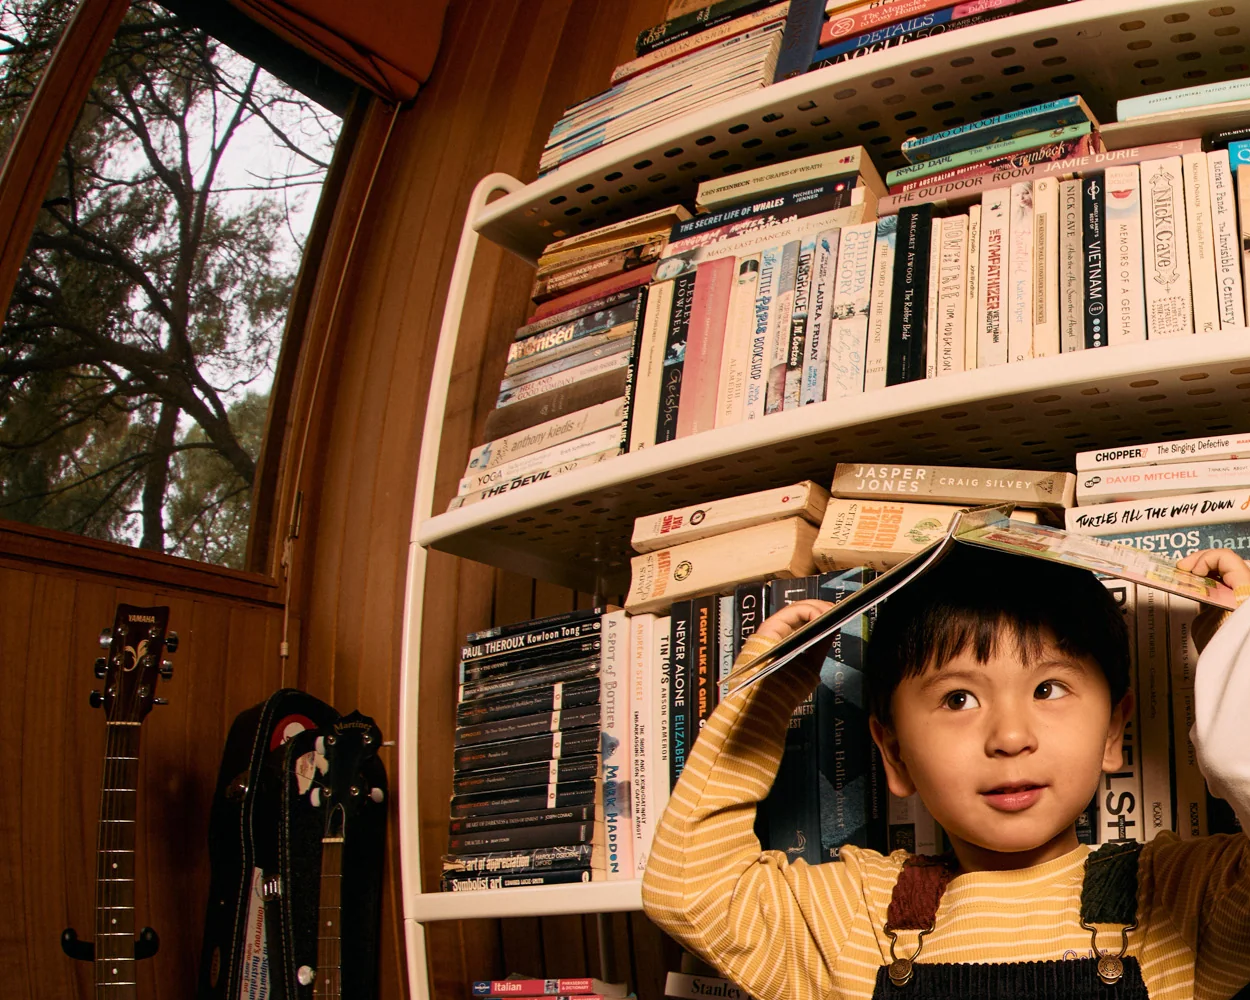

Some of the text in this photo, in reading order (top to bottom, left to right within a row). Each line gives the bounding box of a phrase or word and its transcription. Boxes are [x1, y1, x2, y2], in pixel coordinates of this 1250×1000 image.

[857, 14, 935, 47] DETAILS
[716, 180, 750, 195] STEINBECK
[892, 148, 1139, 204] THE OUTDOOR ROOM JAMIE DURIE
[680, 197, 784, 233] THE SECRET LIFE WHALES
[1066, 185, 1075, 238] NICK CAVE
[755, 230, 791, 245] DANCER
[840, 231, 858, 296] GREGORY
[857, 230, 872, 293] PHILIPPA
[987, 236, 1001, 310] SYMPATHIZER
[1088, 240, 1103, 300] VIETNAM
[1219, 233, 1236, 325] Invisible Century
[672, 279, 688, 335] DOWNER
[810, 283, 826, 361] LAURA FRIDAY
[750, 337, 765, 380] BOOKSHOP
[665, 369, 682, 426] Geisha
[1095, 438, 1230, 462] CHOPPER Singing Defective
[855, 467, 927, 480] JASPER
[857, 479, 920, 493] JONES
[939, 477, 1033, 490] CRAIG SILVEY
[1106, 470, 1198, 485] DAVID MITCHELL
[1076, 512, 1118, 529] TURTLES
[1122, 507, 1143, 521] ALL
[1145, 505, 1169, 519] THE
[1170, 502, 1198, 517] WAY
[1201, 499, 1235, 514] DOWN
[128, 615, 156, 623] YAMAHA
[699, 607, 708, 641] FIGHT
[462, 624, 581, 659] PAUL THEROUX Kowloon Tong
[674, 620, 686, 707] NEVER ALONE
[605, 632, 620, 873] SPOT BOTHER MARK HADDON
[494, 982, 523, 992] Italian
[691, 979, 742, 999] Stanley
